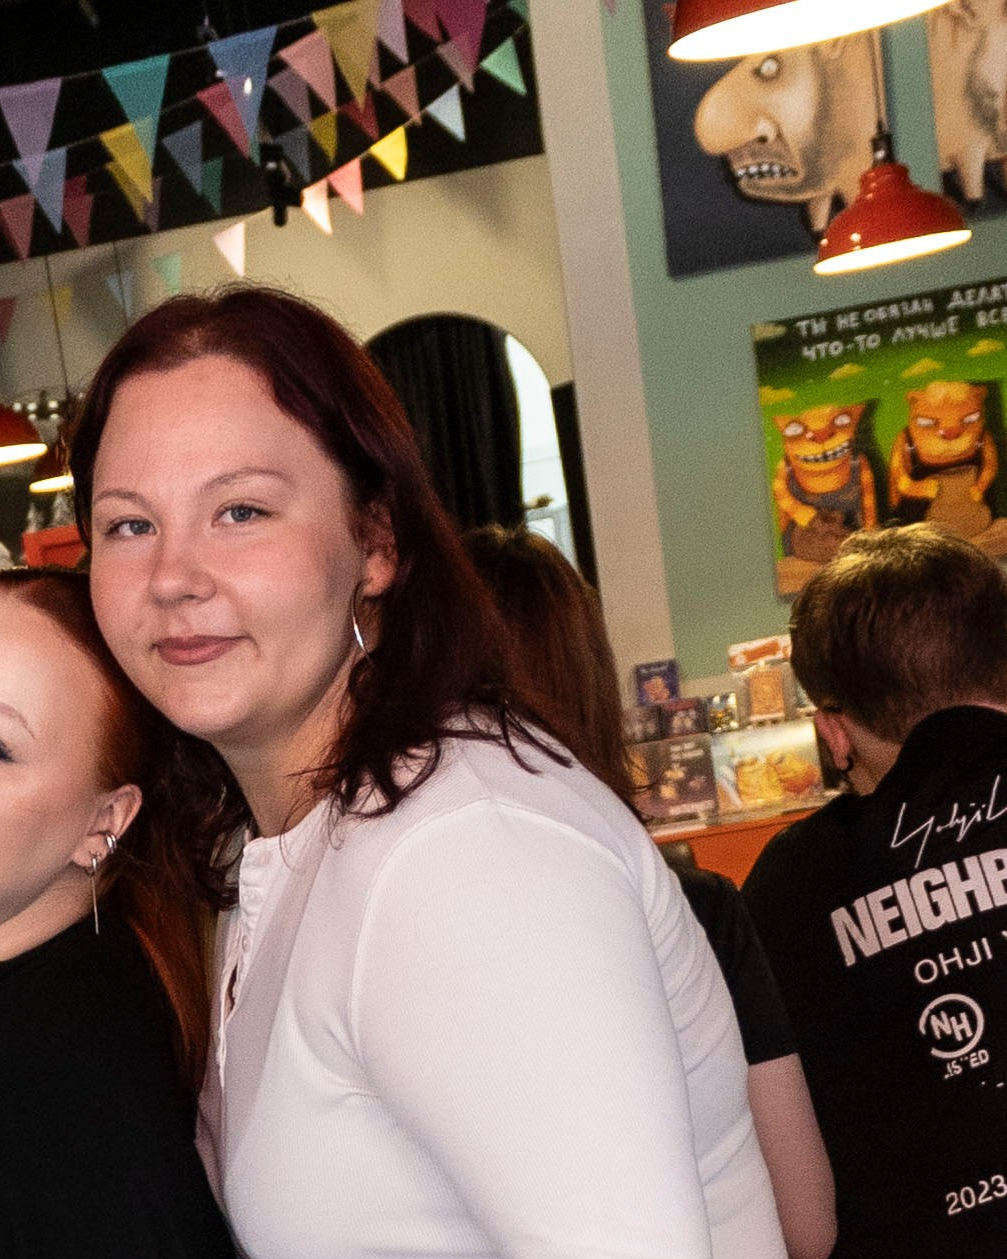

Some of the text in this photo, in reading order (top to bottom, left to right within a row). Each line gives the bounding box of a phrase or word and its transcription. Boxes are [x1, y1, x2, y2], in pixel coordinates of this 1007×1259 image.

[796, 317, 827, 338] ТЫ
[836, 311, 860, 332] НЕ
[801, 333, 881, 361] ЧТО-ТО
[914, 937, 993, 984] OHJI
[930, 1010, 973, 1041] NH
[945, 1174, 1007, 1216] 2023
